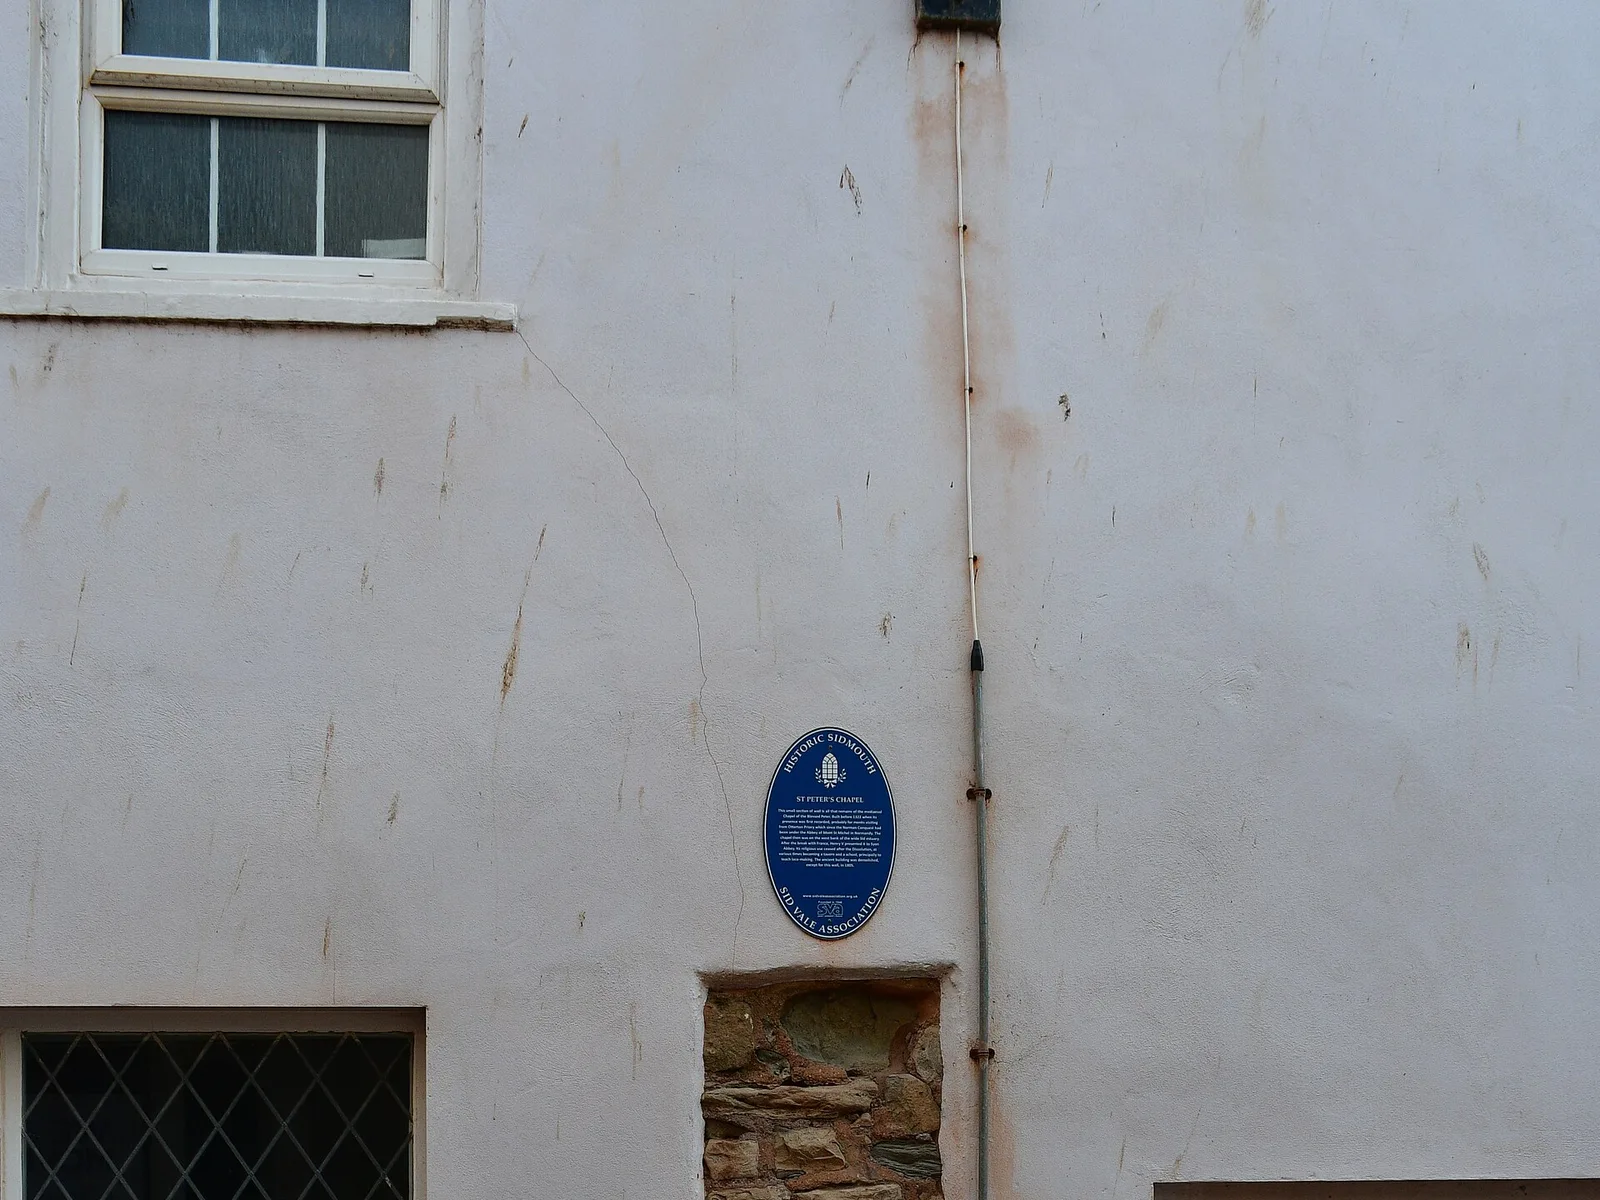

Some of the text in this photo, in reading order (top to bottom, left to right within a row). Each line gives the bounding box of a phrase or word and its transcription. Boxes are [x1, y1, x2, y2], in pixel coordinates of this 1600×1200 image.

[784, 732, 876, 774] HISTORIC SIDMOUTH
[780, 887, 880, 933] SID VALE ASSOCIATION
